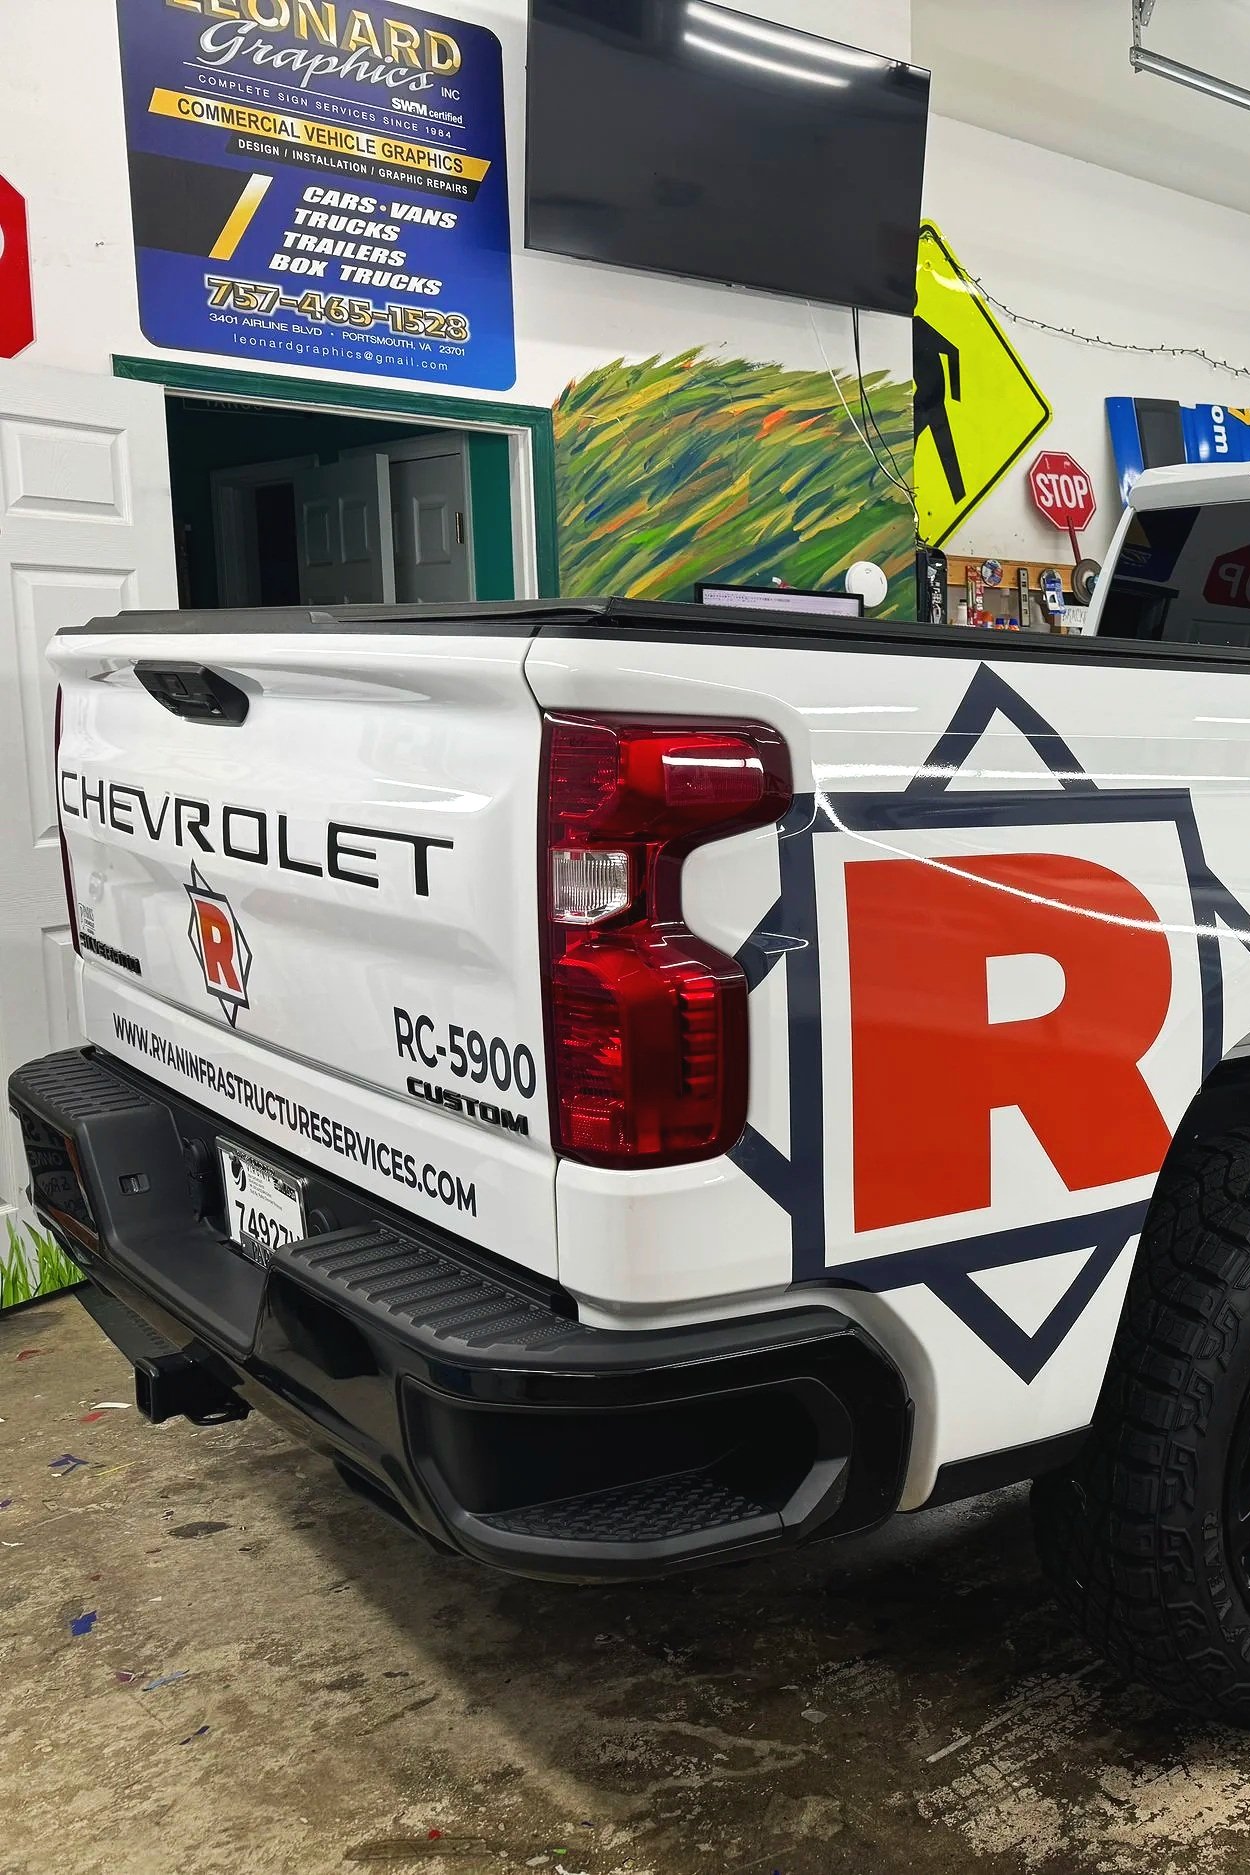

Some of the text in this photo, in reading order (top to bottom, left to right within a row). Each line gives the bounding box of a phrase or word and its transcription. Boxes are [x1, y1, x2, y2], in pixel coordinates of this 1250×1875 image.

[166, 0, 462, 76] EONARD
[196, 19, 461, 101] Graphics INC
[177, 97, 463, 174] COMMERCIAL VEHICLE GRAPHICS
[198, 74, 451, 139] COMPLETE SIGN SERVICES SINCE 1984
[429, 109, 463, 124] certified
[238, 138, 280, 156] DESIGN
[292, 149, 367, 174] INSTALLATION
[378, 168, 423, 185] GRAPHIC
[426, 178, 469, 195] REPAIRS
[293, 207, 401, 242] TRUCKS
[302, 186, 458, 229] CARS VANS
[268, 253, 443, 296] BOX TRUCKS
[282, 231, 407, 267] TRAILERS
[206, 276, 469, 342] 757-465-1528
[209, 313, 238, 325] 3401
[241, 318, 289, 332] AIRLINE
[292, 325, 323, 337] BLVD
[419, 342, 432, 352] VA
[439, 345, 465, 357] 23701
[232, 333, 449, 371] leonardgraphics@gmail.com
[1034, 472, 1089, 509] STOP
[59, 770, 455, 897] CHEVROLET
[193, 899, 243, 995] R
[392, 1006, 537, 1100] RC-5900
[844, 851, 1174, 1234] R
[112, 1011, 478, 1218] WWW.RYANINFRASTRUCTURESERVICES.COM
[406, 1076, 530, 1136] CUSTOM
[235, 1199, 300, 1251] 74927
